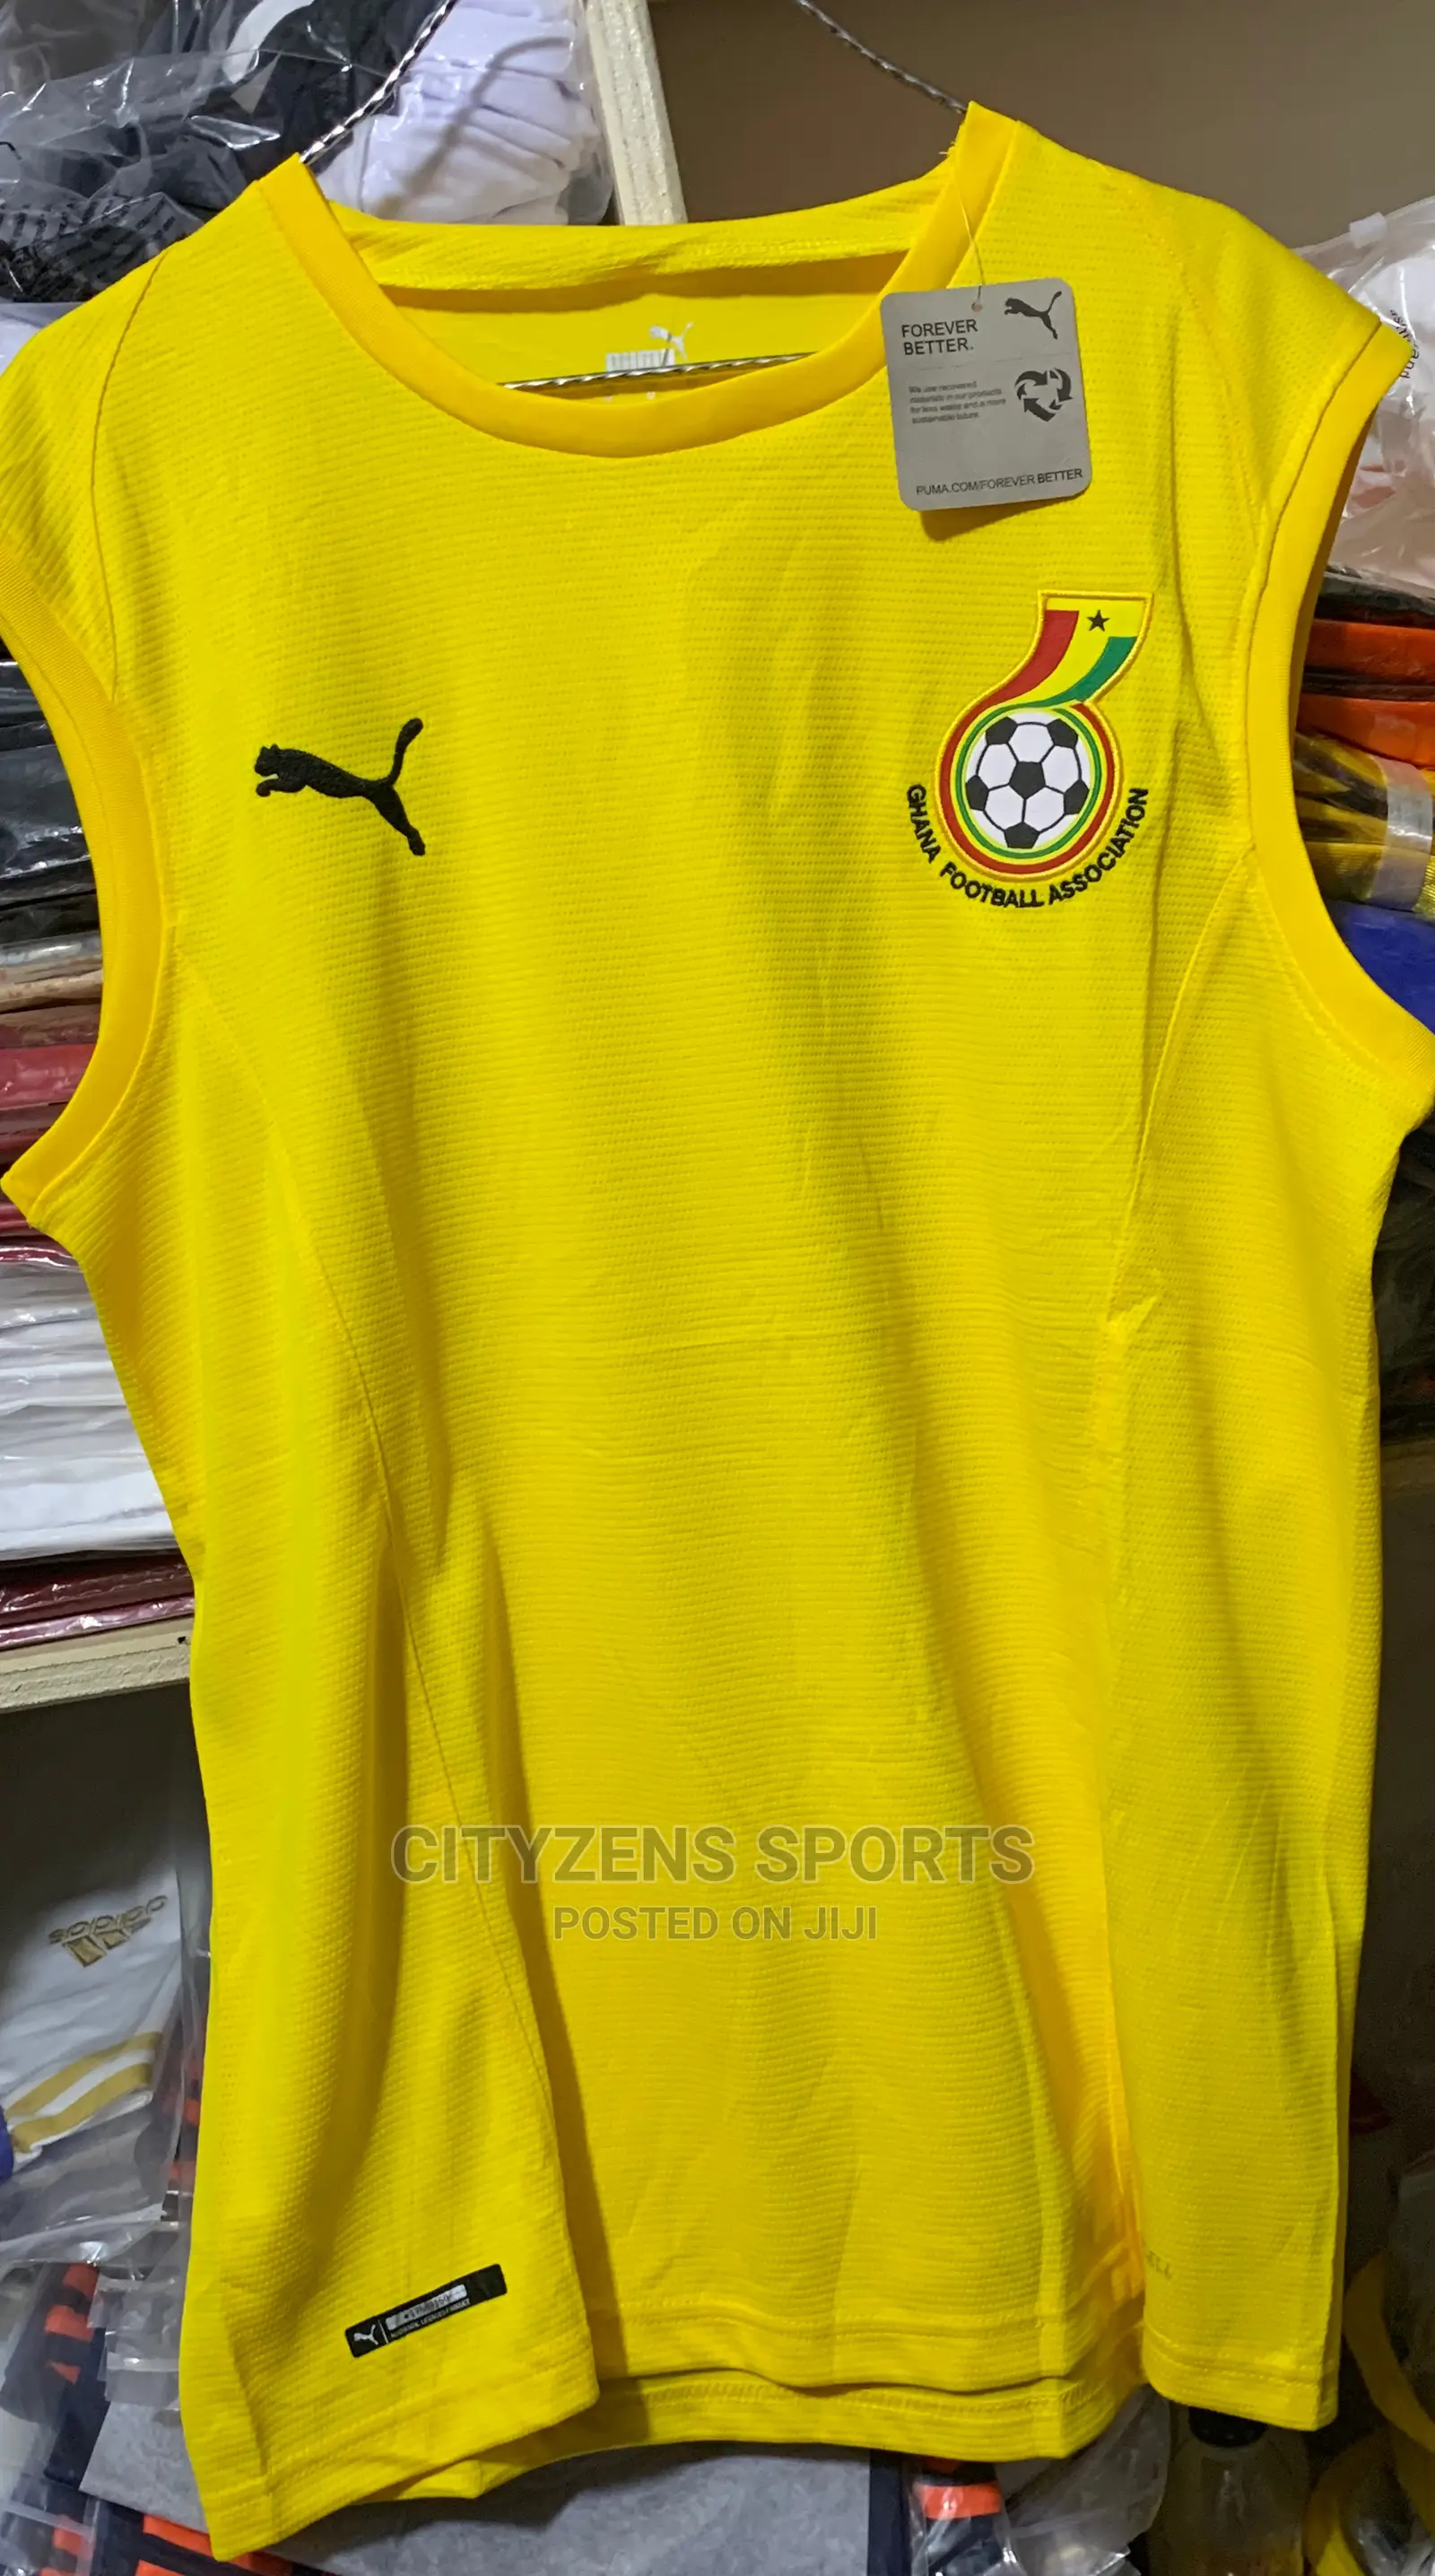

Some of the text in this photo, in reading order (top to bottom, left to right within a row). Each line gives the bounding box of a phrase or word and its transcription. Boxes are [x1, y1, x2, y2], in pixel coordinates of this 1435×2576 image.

[901, 318, 978, 338] FOREVER
[903, 337, 975, 356] BETTER.
[1037, 468, 1083, 484] BETTER
[907, 784, 1150, 908] GHANA FOOTBALL ASSOCIATION
